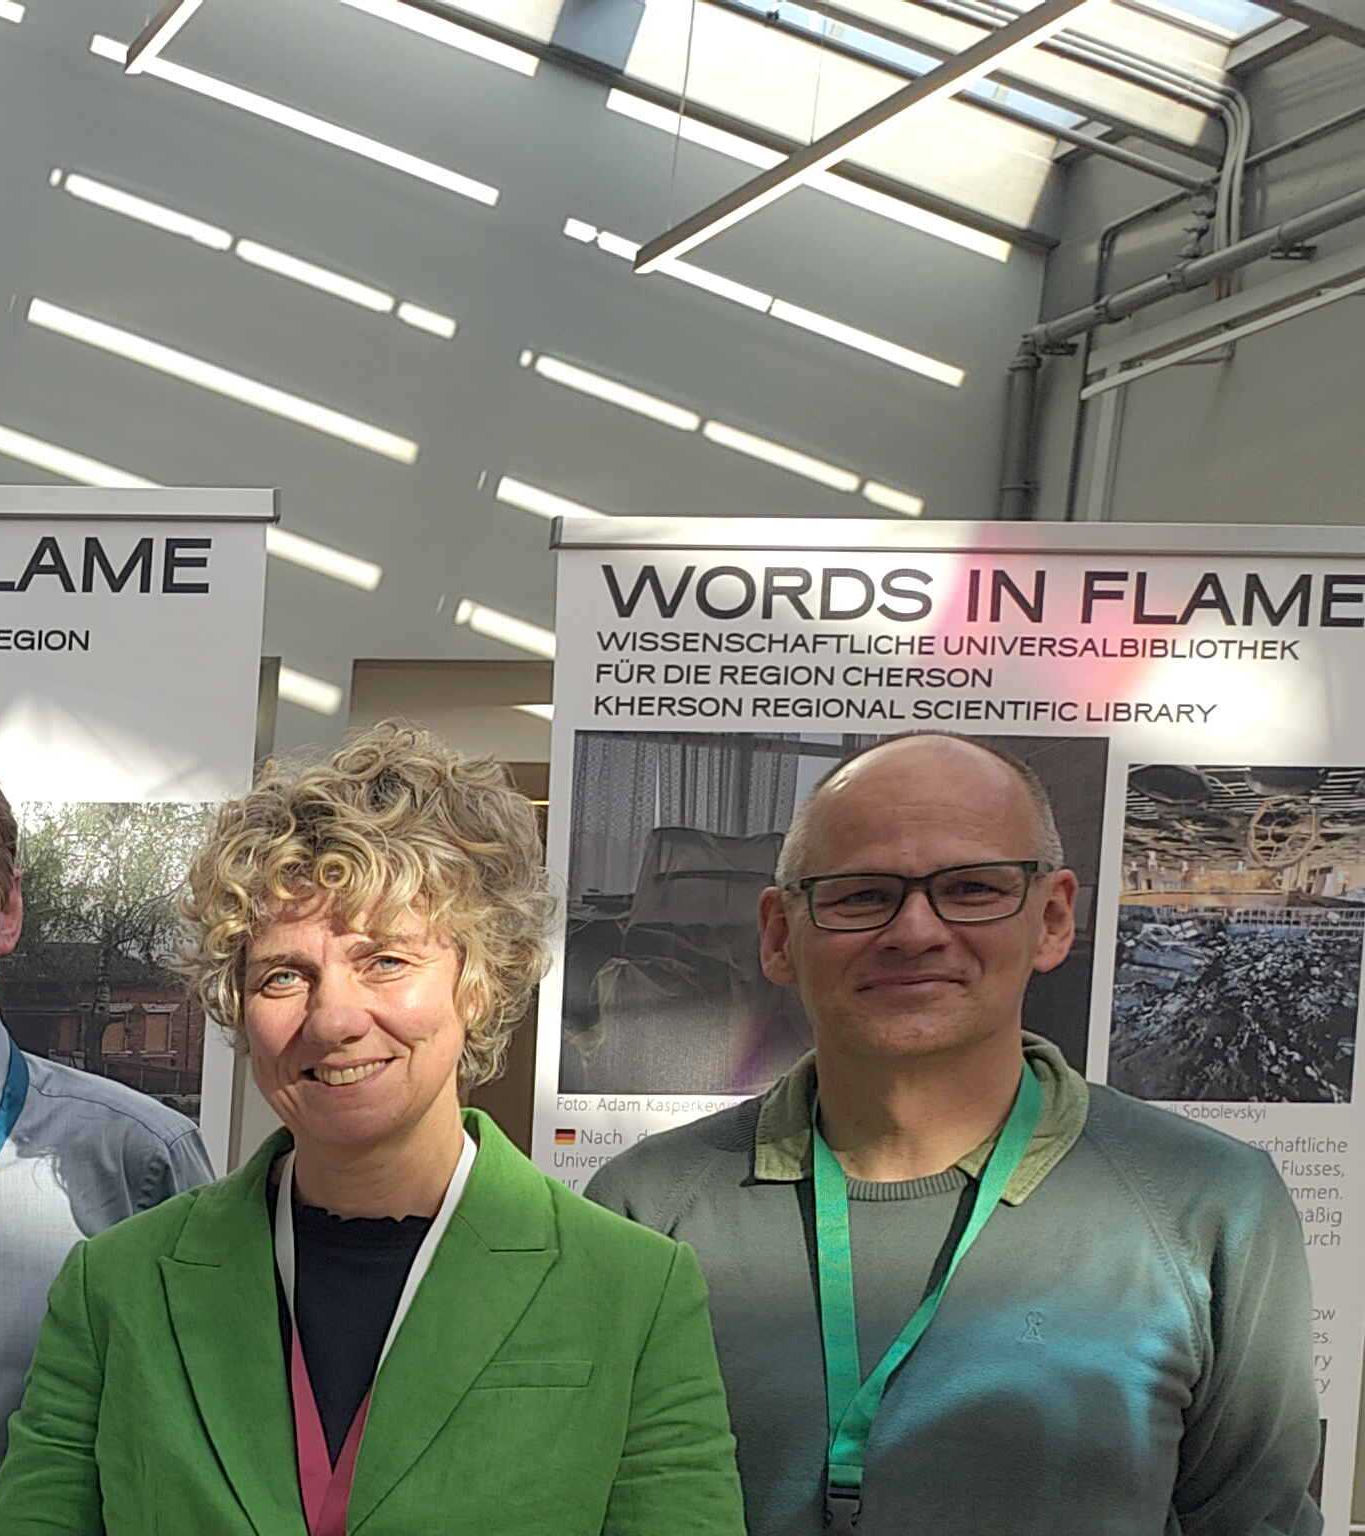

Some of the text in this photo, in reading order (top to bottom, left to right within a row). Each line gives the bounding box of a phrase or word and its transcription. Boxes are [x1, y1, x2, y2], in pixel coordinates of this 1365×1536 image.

[601, 563, 1365, 627] WORDS IN FLAME
[597, 631, 1300, 661] WISSENSCHAFTLICHE UNIVERSALBIBLIOTHEK
[596, 661, 993, 688] FÜR DIE REGION CHERSON
[594, 696, 1217, 725] KHERSON REGIONAL SCIENTIFIC LIBRARY
[557, 1097, 640, 1112] Foto: Adam
[1183, 1104, 1266, 1122] Sobolevskyi
[581, 1129, 622, 1145] Nach
[1281, 1160, 1345, 1178] Flusses,
